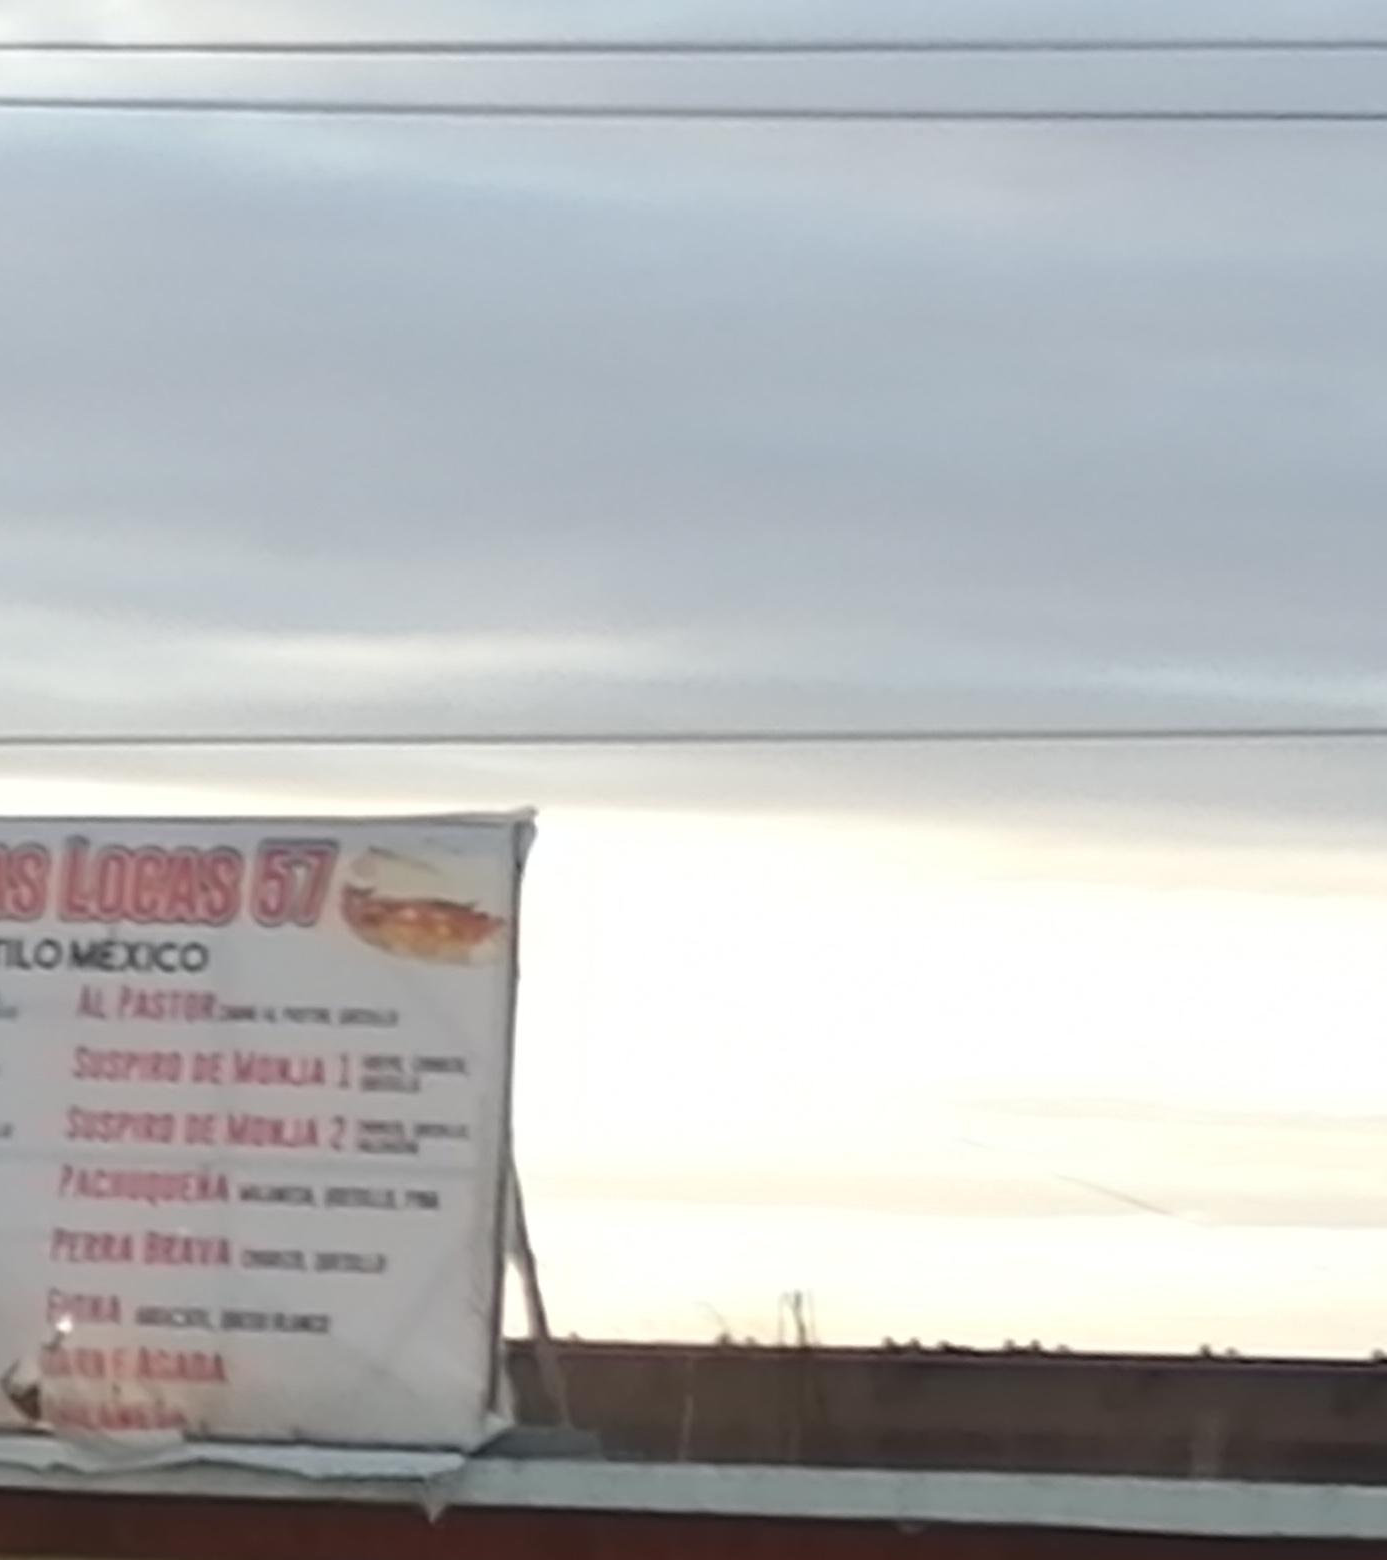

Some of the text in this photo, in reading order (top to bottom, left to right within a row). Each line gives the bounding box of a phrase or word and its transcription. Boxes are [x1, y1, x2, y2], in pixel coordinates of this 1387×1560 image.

[57, 834, 244, 924] LOCAS
[251, 838, 339, 927] 57
[77, 984, 106, 1020] AL
[118, 985, 217, 1024] PASTOR
[72, 1046, 181, 1083] SUSPIRO
[192, 1051, 223, 1085] DE
[233, 1050, 326, 1088] MONJA
[337, 1055, 351, 1089] 1
[66, 1105, 174, 1143] SUSPIRO
[184, 1110, 216, 1145] DE
[226, 1110, 319, 1148] MONJA
[329, 1114, 347, 1151] 2
[51, 1227, 132, 1265] PERRA
[144, 1231, 231, 1267] BRAVA
